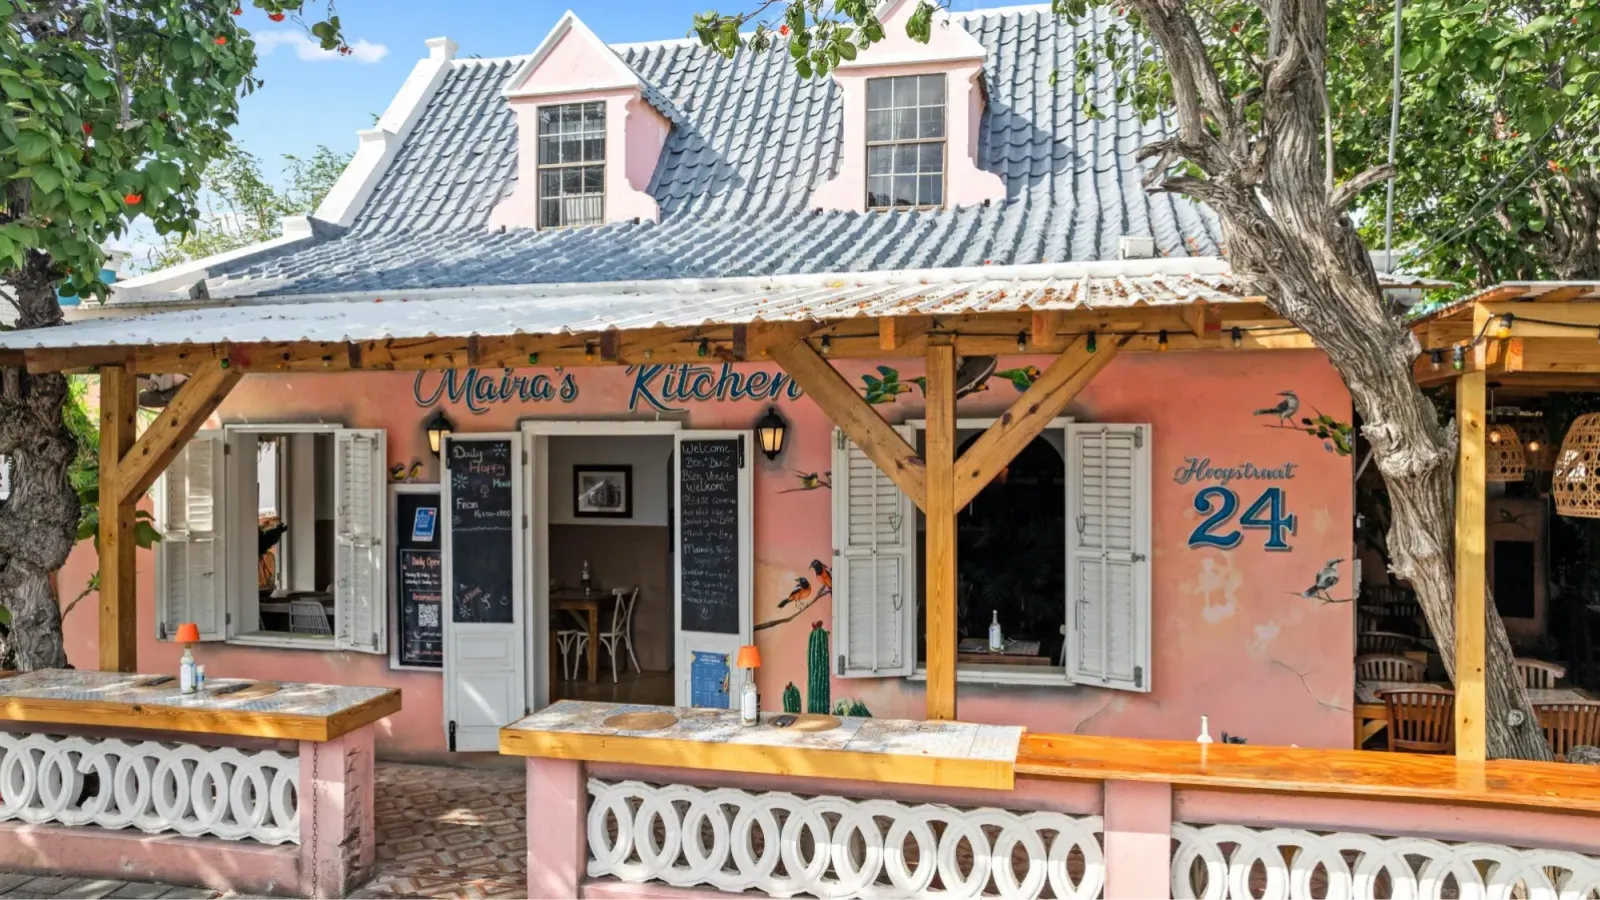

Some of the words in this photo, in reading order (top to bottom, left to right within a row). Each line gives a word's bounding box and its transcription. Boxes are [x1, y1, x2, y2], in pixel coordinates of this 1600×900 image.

[413, 367, 579, 414] Maira's
[625, 362, 804, 412] Kitchen
[452, 445, 483, 463] Daily
[469, 461, 506, 476] Happy
[1173, 456, 1298, 485] Hoogstraat
[1187, 485, 1298, 552] 24
[411, 556, 426, 569] Daily
